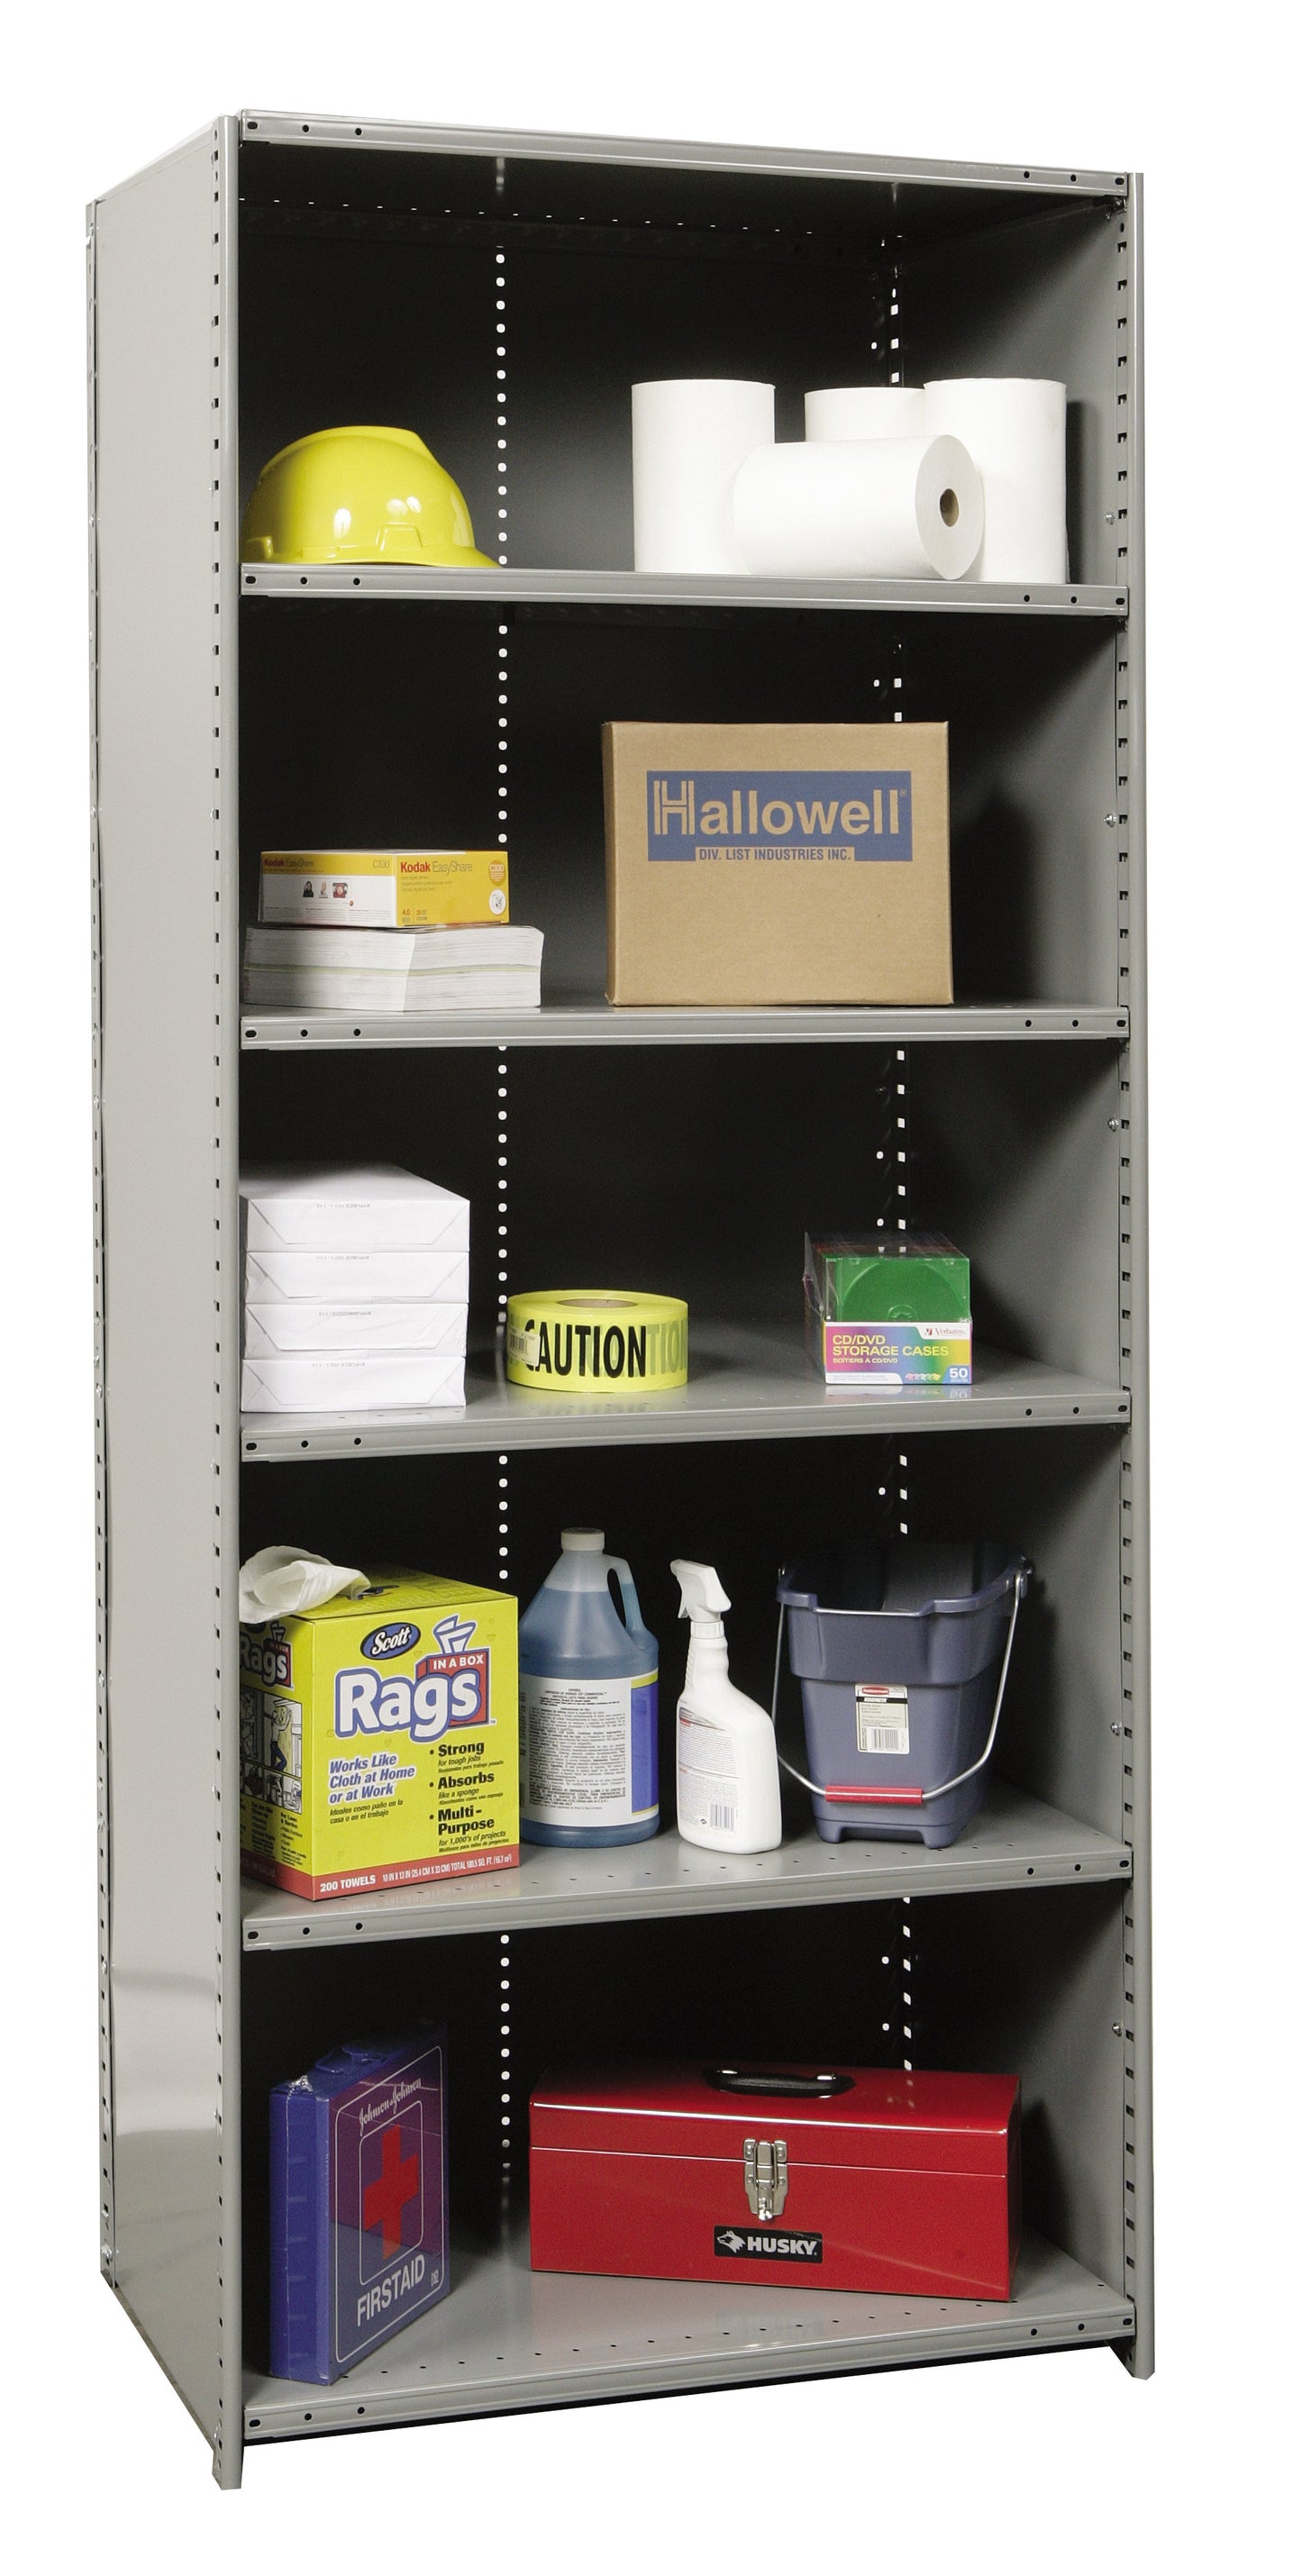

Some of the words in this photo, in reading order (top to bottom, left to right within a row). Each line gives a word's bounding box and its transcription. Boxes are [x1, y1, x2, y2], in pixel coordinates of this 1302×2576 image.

[653, 780, 899, 835] Hallowell
[699, 849, 722, 860] DIV.
[725, 849, 751, 860] LIST
[754, 849, 824, 860] INDUSTRIES
[827, 849, 851, 860] INC.
[401, 861, 431, 872] Kodak
[432, 860, 473, 875] EasyShare
[833, 1334, 886, 1345] CD/DVD
[833, 1346, 898, 1356] STORAGE
[902, 1346, 949, 1356] CASES
[950, 1368, 968, 1378] 50
[371, 1625, 411, 1656] Scott
[433, 1659, 446, 1670] IN
[449, 1658, 457, 1667] A
[460, 1654, 484, 1667] BOX
[339, 1672, 478, 1737] Rags
[438, 1743, 484, 1757] Strong
[330, 1758, 369, 1774] Works
[371, 1754, 396, 1768] Like
[330, 1772, 361, 1789] Cloth
[364, 1771, 377, 1783] at
[379, 1767, 414, 1781] Home
[438, 1771, 495, 1789] Absorbs
[329, 1794, 342, 1803] or
[346, 1789, 358, 1801] at
[361, 1783, 394, 1798] Work
[457, 1788, 479, 1798] sponge
[330, 1807, 352, 1816] Ideales
[438, 1819, 495, 1835] Purpose
[480, 1831, 505, 1841] projects
[451, 1861, 466, 1871] TOTAL
[320, 1882, 338, 1892] 200
[341, 1875, 376, 1889] TOWELS
[746, 2236, 817, 2256] HUSKY
